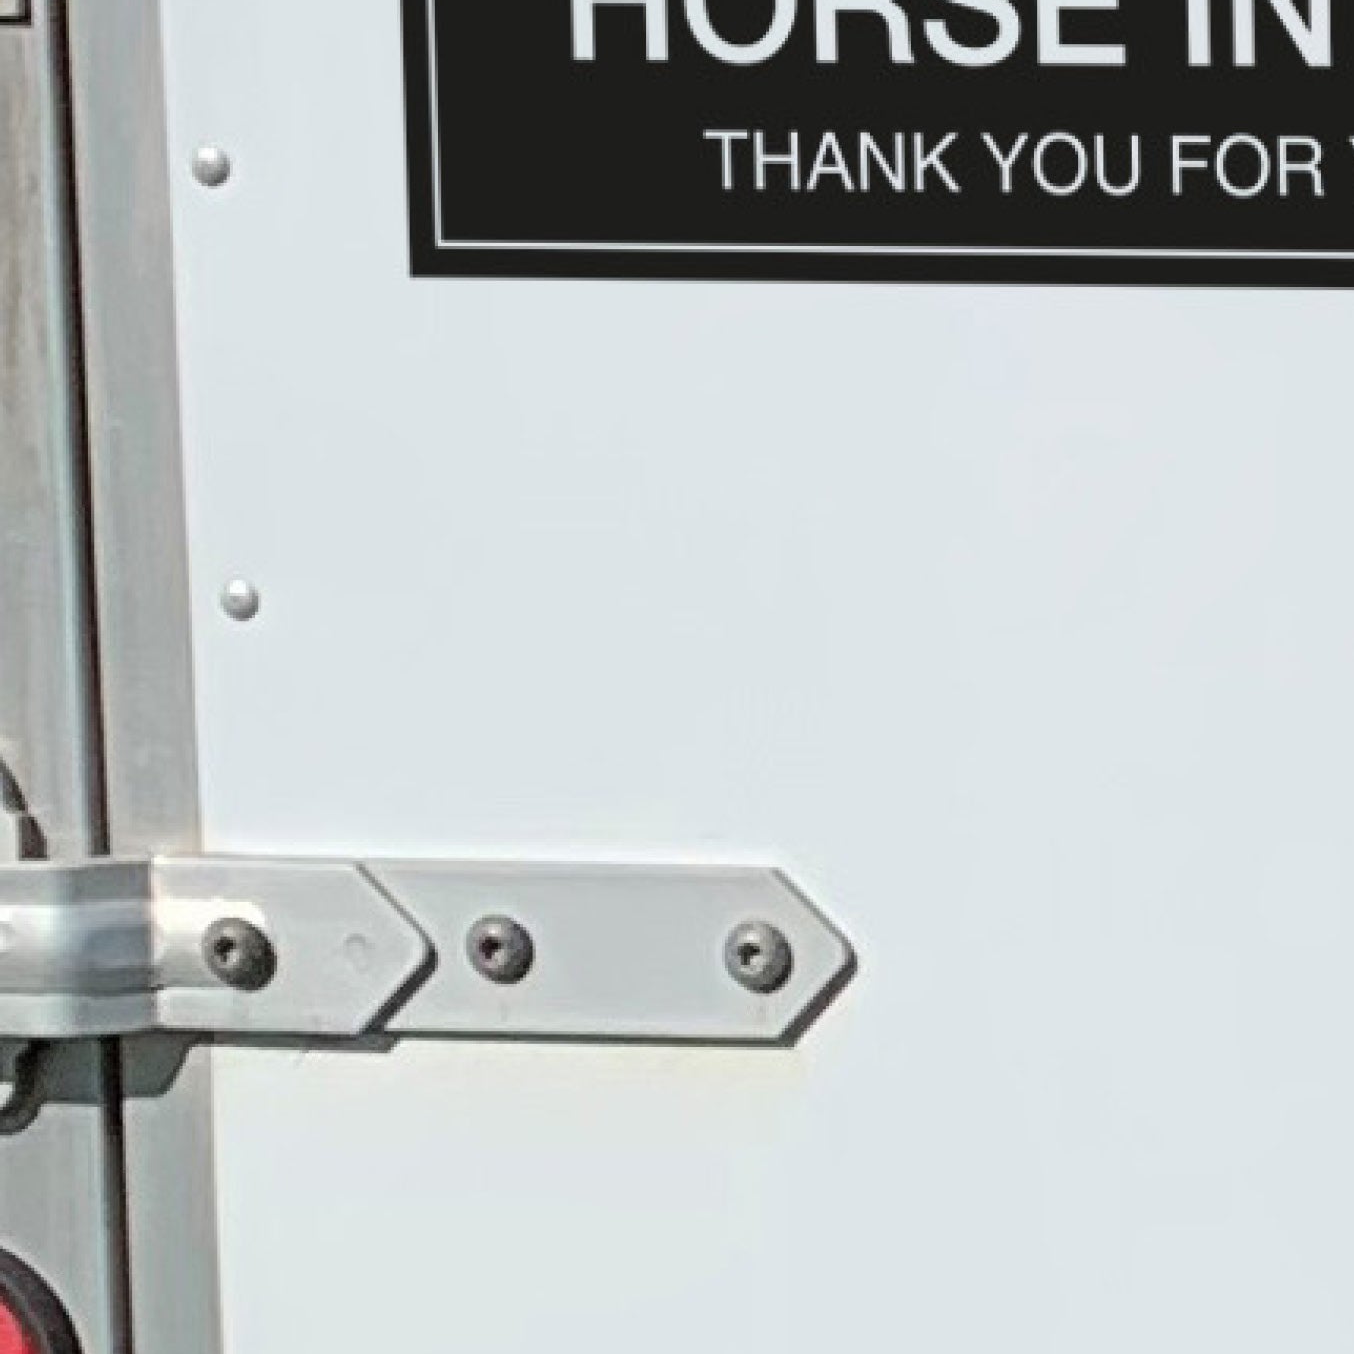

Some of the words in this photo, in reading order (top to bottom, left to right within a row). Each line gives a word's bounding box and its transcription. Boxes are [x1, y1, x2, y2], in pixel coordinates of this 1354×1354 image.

[702, 129, 960, 193] THANK
[982, 131, 1139, 196] YOU
[1172, 134, 1325, 197] FOR
